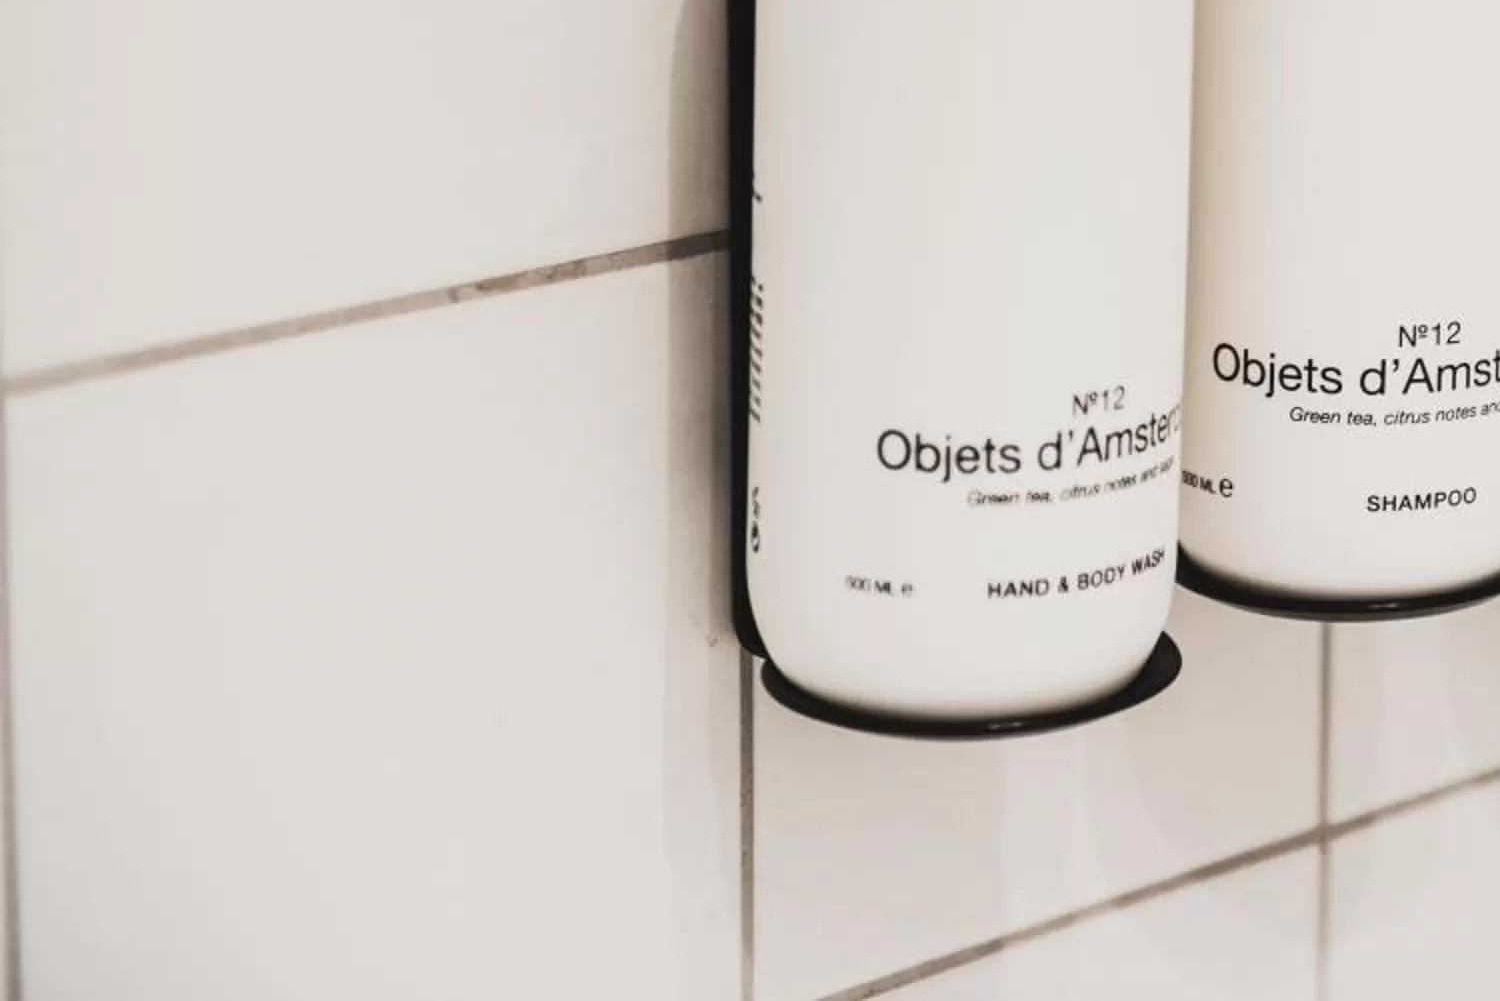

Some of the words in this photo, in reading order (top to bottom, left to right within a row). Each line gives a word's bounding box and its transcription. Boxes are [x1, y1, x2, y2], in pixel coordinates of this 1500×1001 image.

[1212, 342, 1344, 398] Objets
[1289, 406, 1342, 424] Green
[1347, 410, 1377, 427] tea,
[1383, 409, 1431, 426] citrus
[1435, 405, 1477, 422] notes
[876, 429, 1022, 483] Objets
[1366, 486, 1478, 513] SHAMPOO
[987, 578, 1050, 599] HAND
[1057, 575, 1070, 594] &
[1077, 563, 1127, 591] BODY
[1130, 547, 1166, 576] WASH
